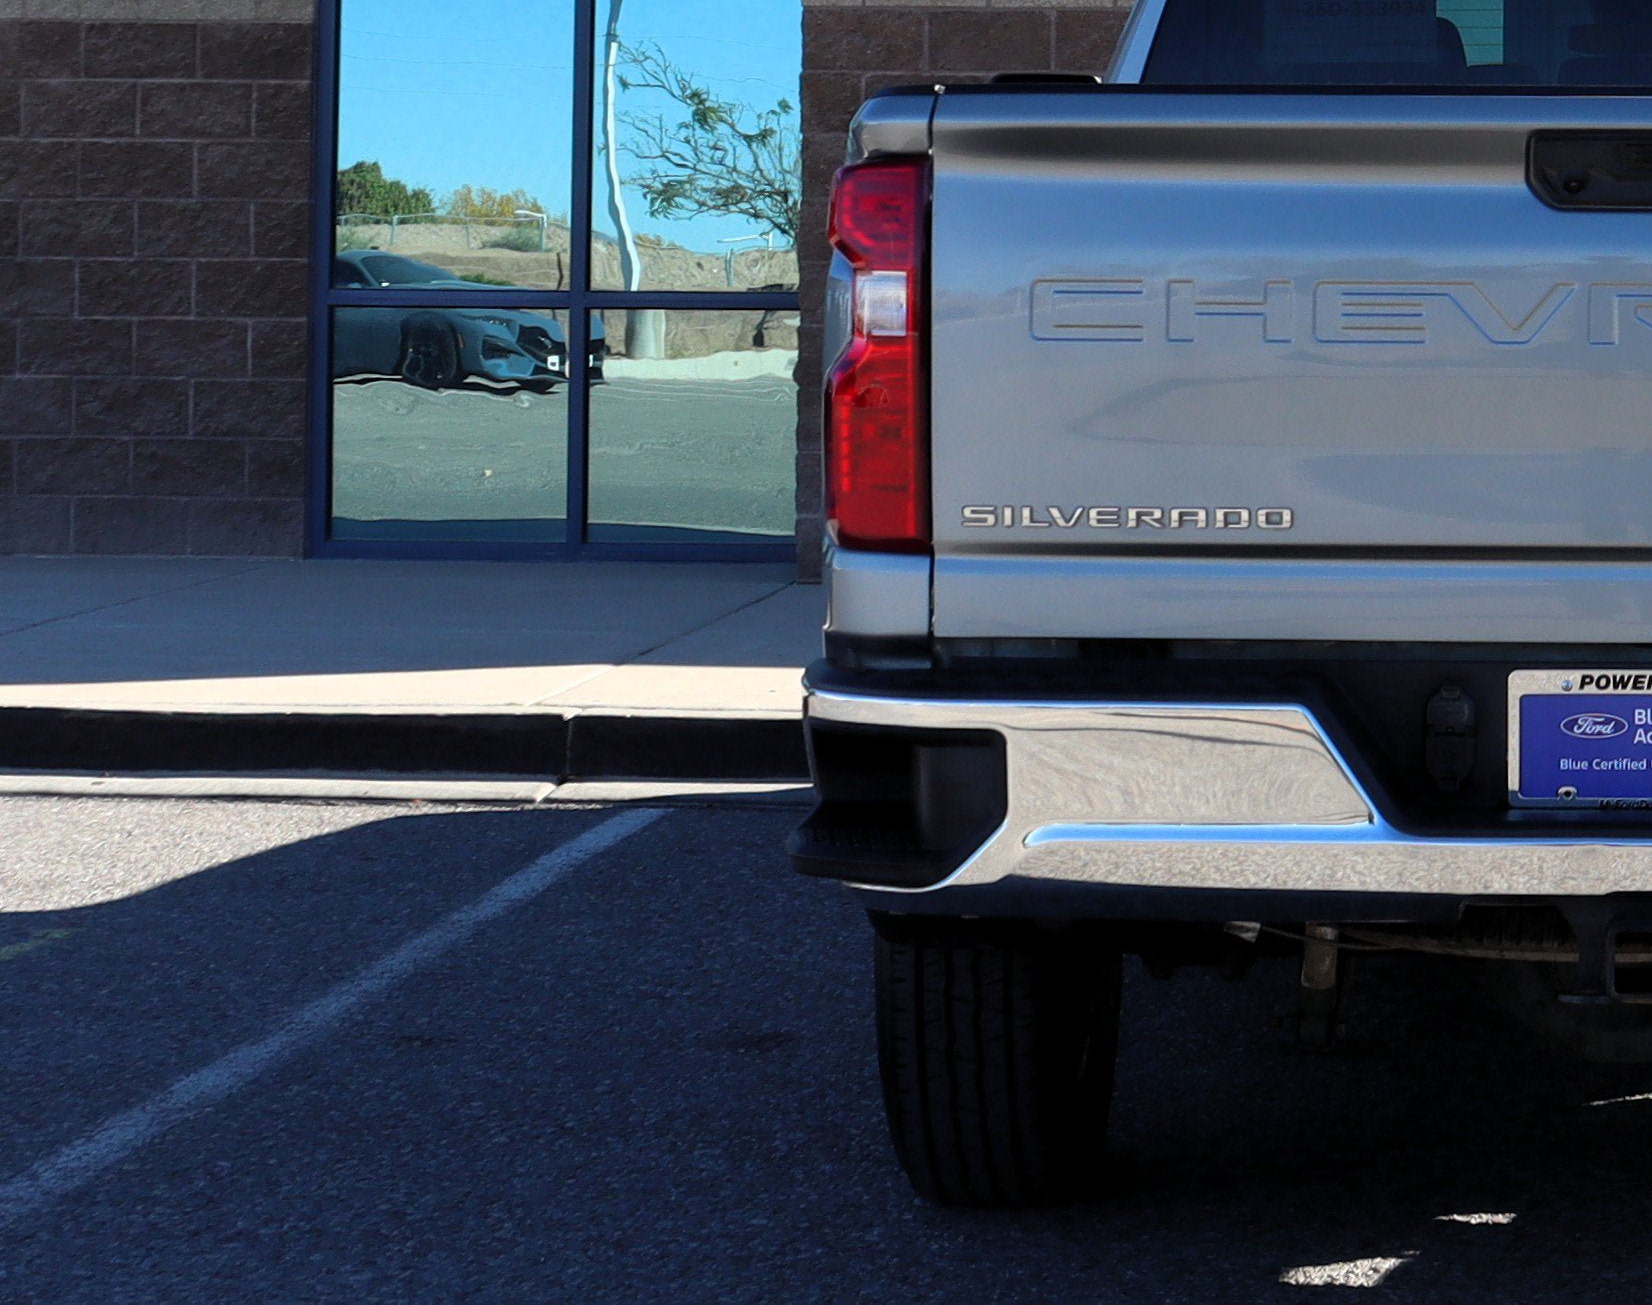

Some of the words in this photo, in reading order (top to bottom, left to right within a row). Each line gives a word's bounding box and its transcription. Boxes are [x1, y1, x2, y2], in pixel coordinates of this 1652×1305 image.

[960, 504, 1295, 530] SILVERADO
[1573, 717, 1615, 736] Ford
[1559, 758, 1588, 771] Blue
[1592, 758, 1647, 771] Certified
